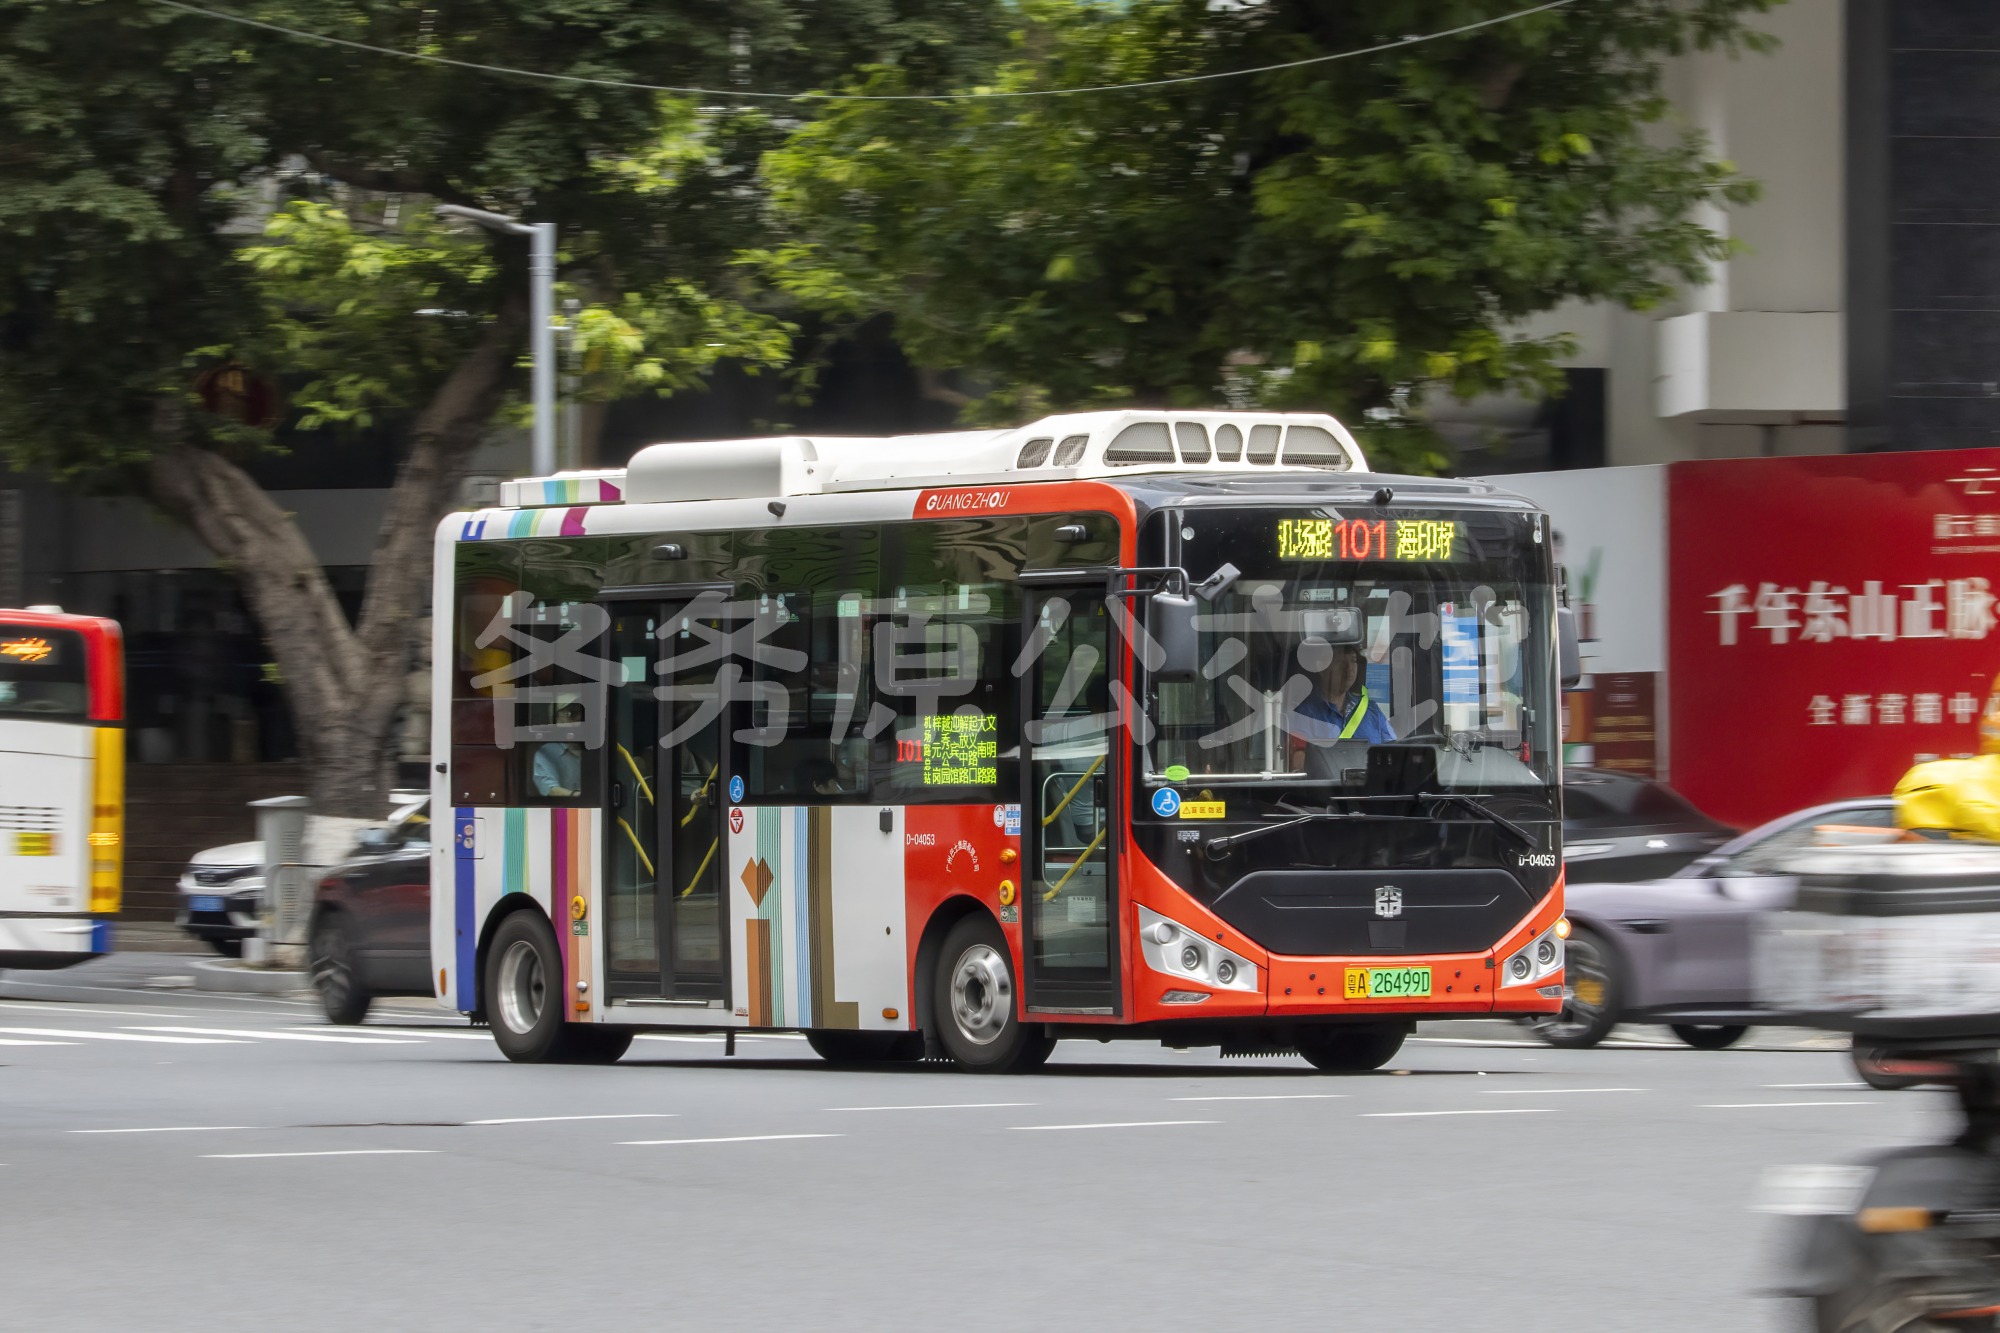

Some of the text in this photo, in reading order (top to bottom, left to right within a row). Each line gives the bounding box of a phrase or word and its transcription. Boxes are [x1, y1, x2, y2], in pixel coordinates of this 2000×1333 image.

[926, 491, 1010, 511] GUANGZHOU
[1334, 518, 1387, 560] 101
[897, 739, 923, 762] 101
[932, 715, 941, 785] 梓元岗
[941, 715, 950, 785] 越秀公园
[950, 715, 960, 785] 迎宾馆
[959, 715, 969, 785] 解放中路
[968, 715, 978, 785] 起义路口
[977, 715, 987, 785] 大南路
[986, 715, 997, 785] 文明路
[906, 834, 935, 845] D-04053
[1518, 854, 1556, 867] D-04053
